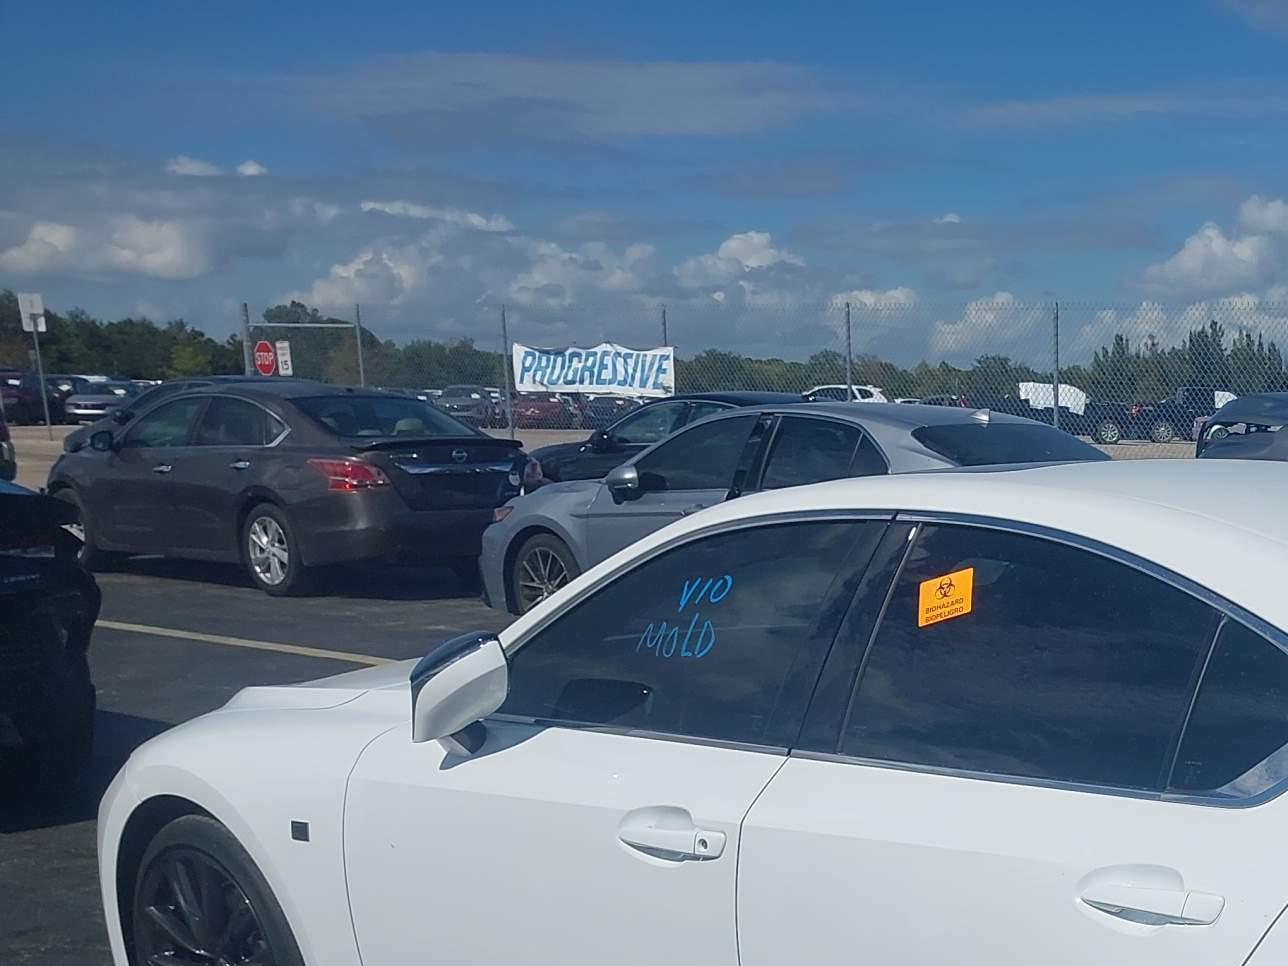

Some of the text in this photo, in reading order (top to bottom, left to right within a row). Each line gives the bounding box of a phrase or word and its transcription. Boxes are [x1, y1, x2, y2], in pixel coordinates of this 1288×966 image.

[255, 352, 274, 365] STOP
[519, 350, 670, 390] PROGRESSIVE
[925, 598, 964, 615] BIOHAZARD
[925, 606, 964, 623] BIOPELIGRO
[636, 613, 716, 658] MOLD
